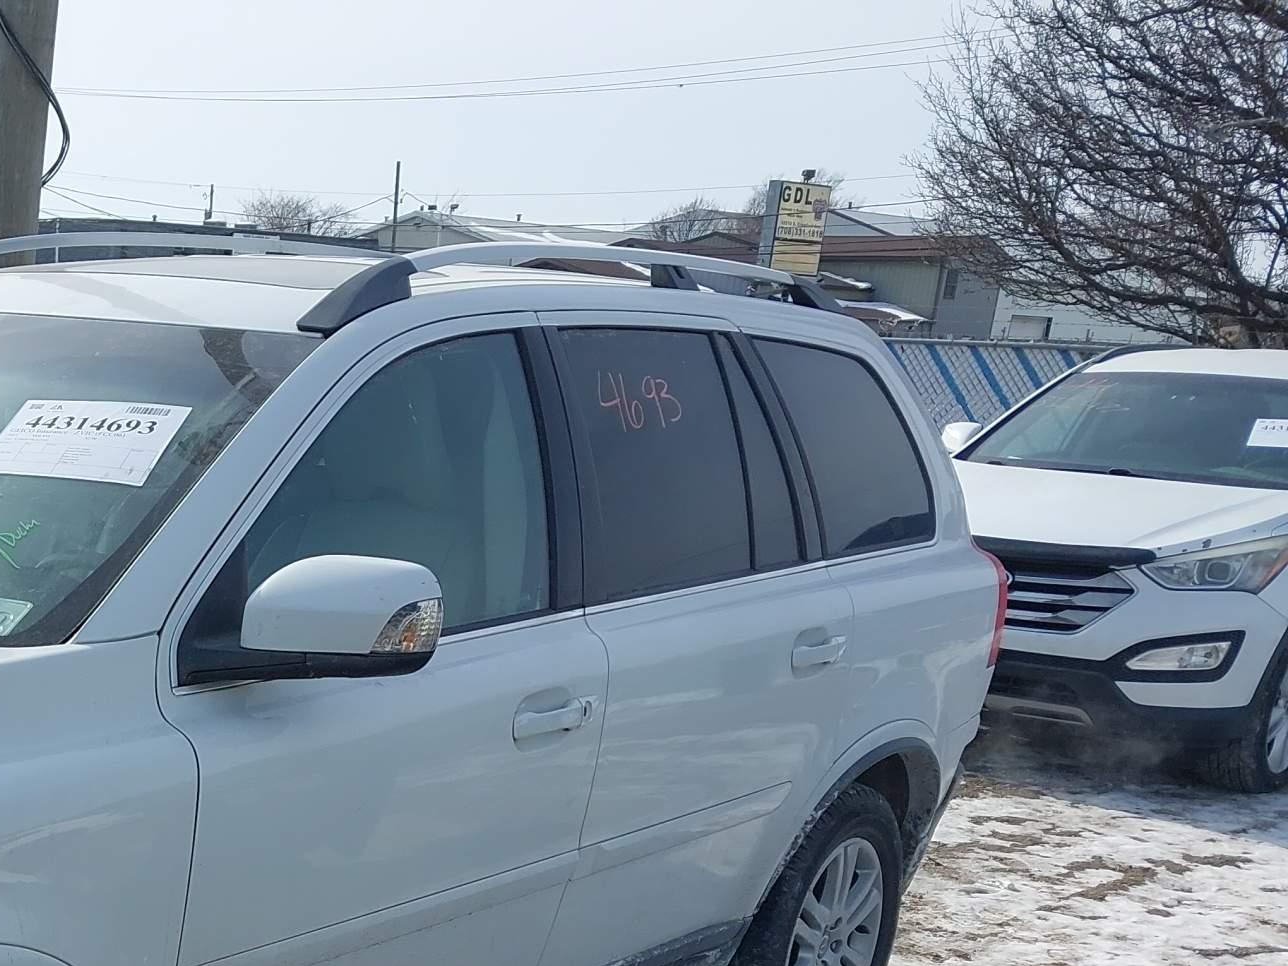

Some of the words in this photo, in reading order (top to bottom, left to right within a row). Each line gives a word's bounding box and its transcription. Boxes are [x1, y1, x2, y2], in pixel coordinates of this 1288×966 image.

[782, 185, 813, 205] GDL
[598, 368, 682, 432] 4693
[25, 415, 158, 435] 44314693
